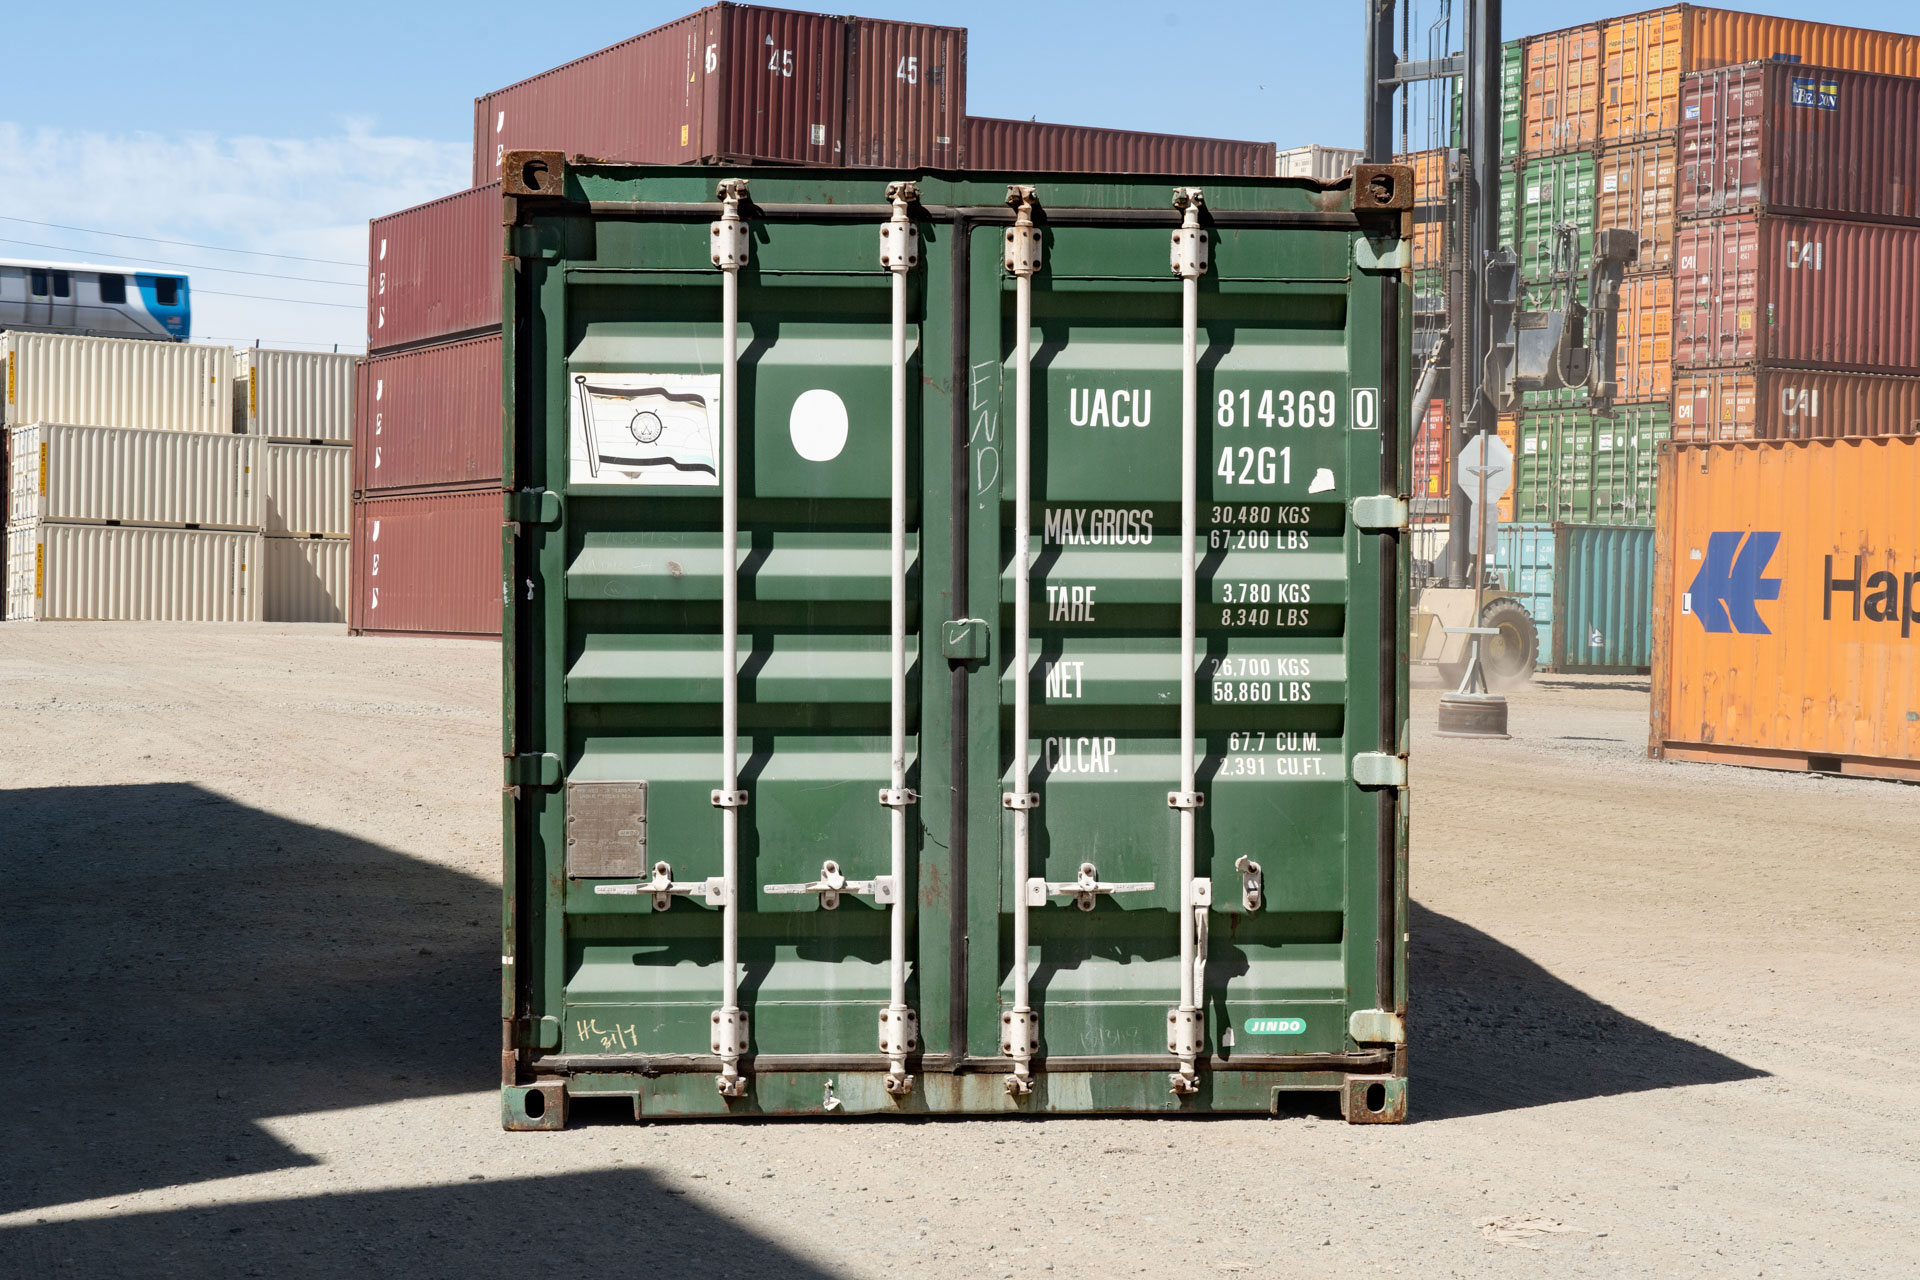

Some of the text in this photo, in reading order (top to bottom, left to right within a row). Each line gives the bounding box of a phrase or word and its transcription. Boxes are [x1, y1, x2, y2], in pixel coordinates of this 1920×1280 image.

[768, 49, 792, 77] 45
[897, 56, 917, 84] 45
[1682, 256, 1696, 269] CAI
[1787, 241, 1822, 270] CAI
[1070, 388, 1374, 428] UACU 814369 0
[1678, 406, 1692, 418] CAI
[1782, 388, 1818, 417] CAI
[1218, 446, 1292, 485] 42G1
[1044, 509, 1153, 546] MAX.GROSS
[1211, 506, 1310, 525] 30,480 KGS
[1210, 530, 1309, 550] 67,200 LBS
[1047, 586, 1096, 622] TARE
[1224, 584, 1310, 604] 3,780 KGS
[1823, 554, 1920, 638] Hap
[1222, 609, 1308, 627] 8,340 LBS
[1046, 662, 1084, 698] NET
[1212, 658, 1310, 678] 26,700 KGS
[1214, 682, 1311, 702] 58,860 LBS
[1230, 732, 1320, 752] 67.7 CU.M.
[1045, 737, 1118, 773] CU.CAP.
[1220, 758, 1326, 777] 2,391 CU.FT.
[1252, 1021, 1300, 1032] JINDO
